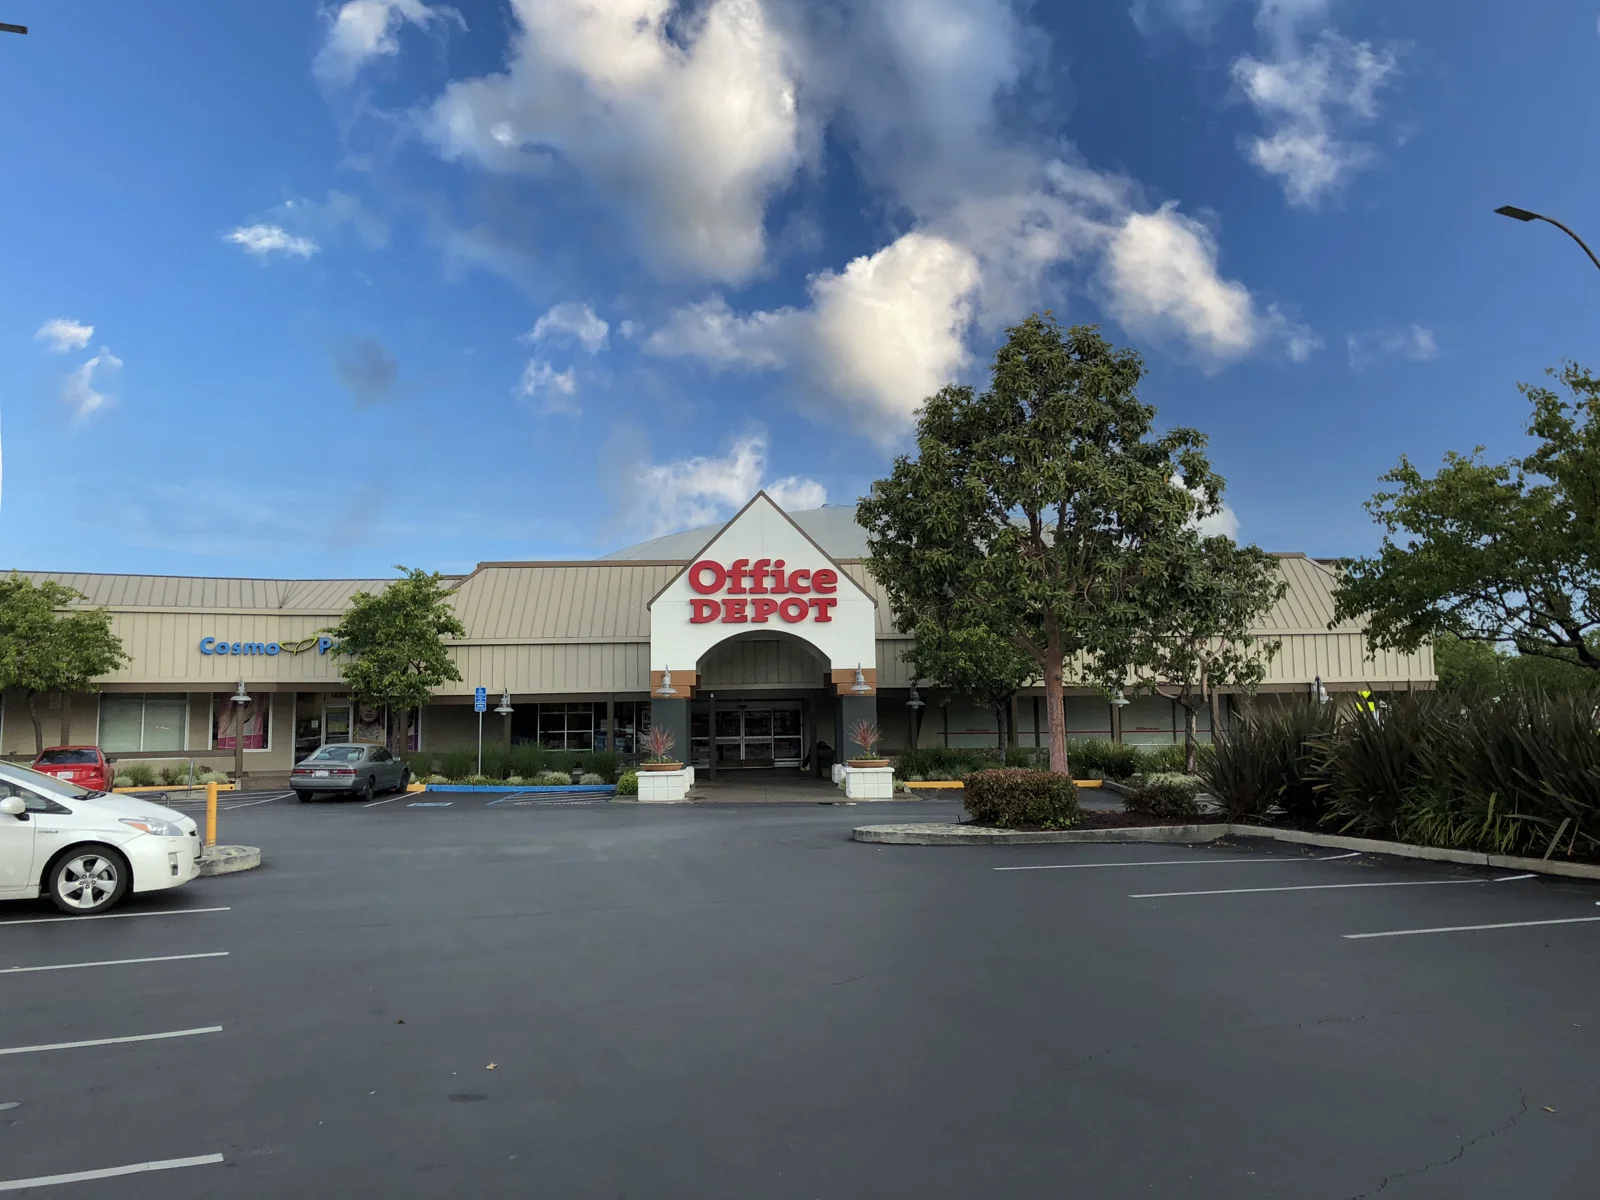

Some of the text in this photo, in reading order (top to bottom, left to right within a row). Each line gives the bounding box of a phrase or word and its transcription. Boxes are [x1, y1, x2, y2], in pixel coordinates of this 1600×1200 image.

[688, 558, 838, 595] Office
[689, 597, 838, 624] DEPOT
[199, 636, 281, 656] Cosmo
